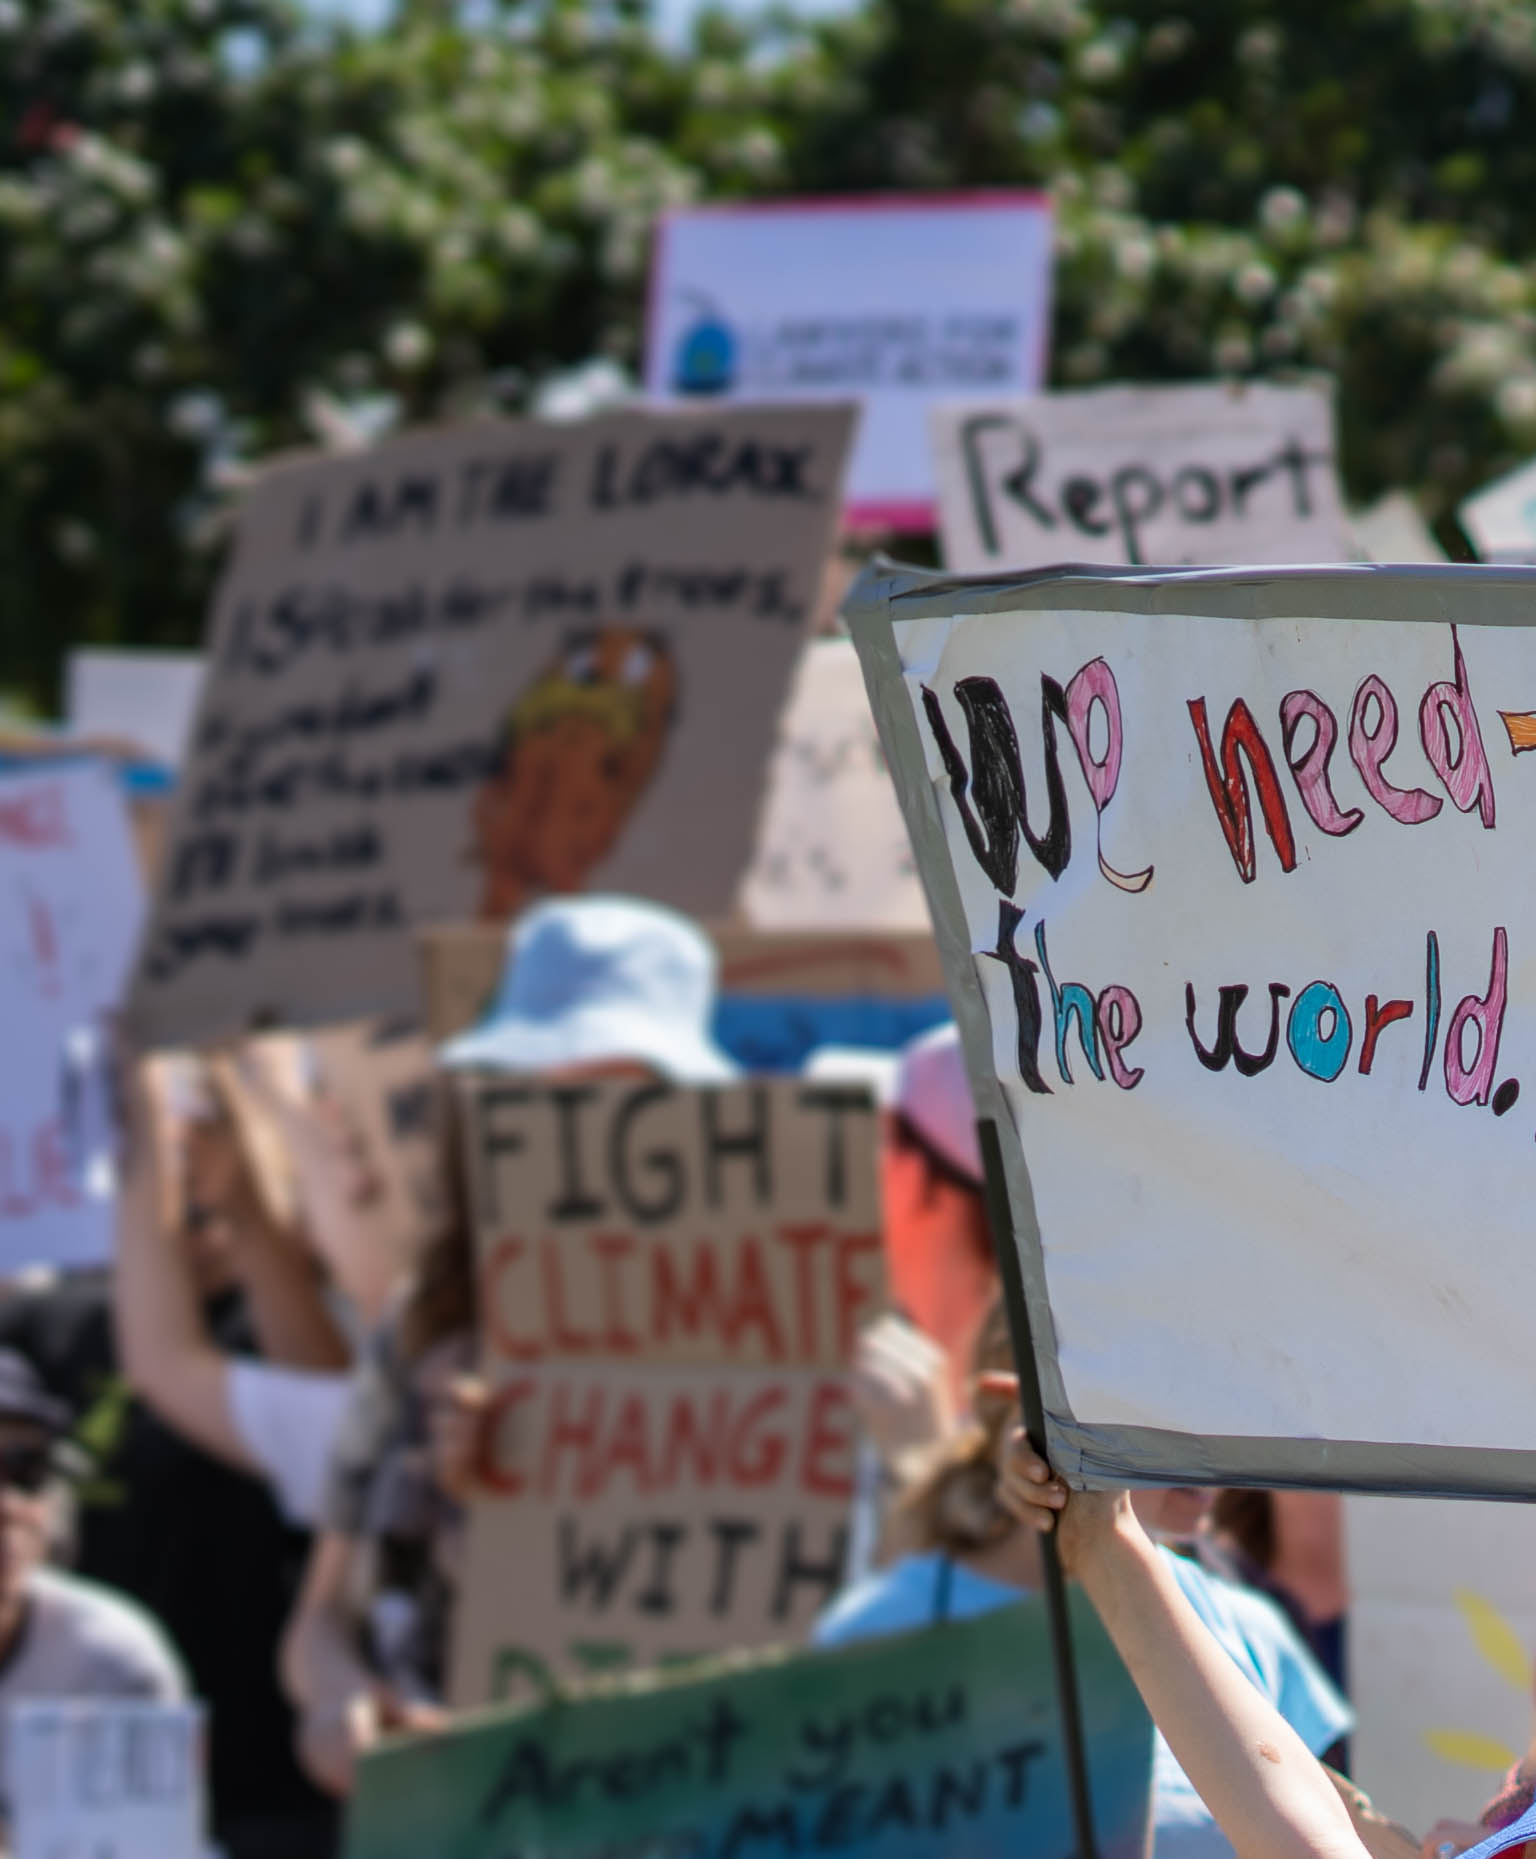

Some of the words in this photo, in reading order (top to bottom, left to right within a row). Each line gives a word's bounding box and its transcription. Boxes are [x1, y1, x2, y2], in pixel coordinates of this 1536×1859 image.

[339, 469, 442, 542] AM
[459, 452, 564, 526] THE
[961, 414, 1335, 563] Report
[920, 655, 1155, 898] We
[1186, 622, 1496, 884] need
[985, 899, 1144, 1094] the
[1184, 927, 1520, 1117] world.
[474, 1082, 878, 1225] FIGHT
[483, 1225, 887, 1364] CLIMATE
[472, 1380, 858, 1502] CHANGE
[556, 1514, 854, 1624] WITH
[789, 1685, 967, 1793] you
